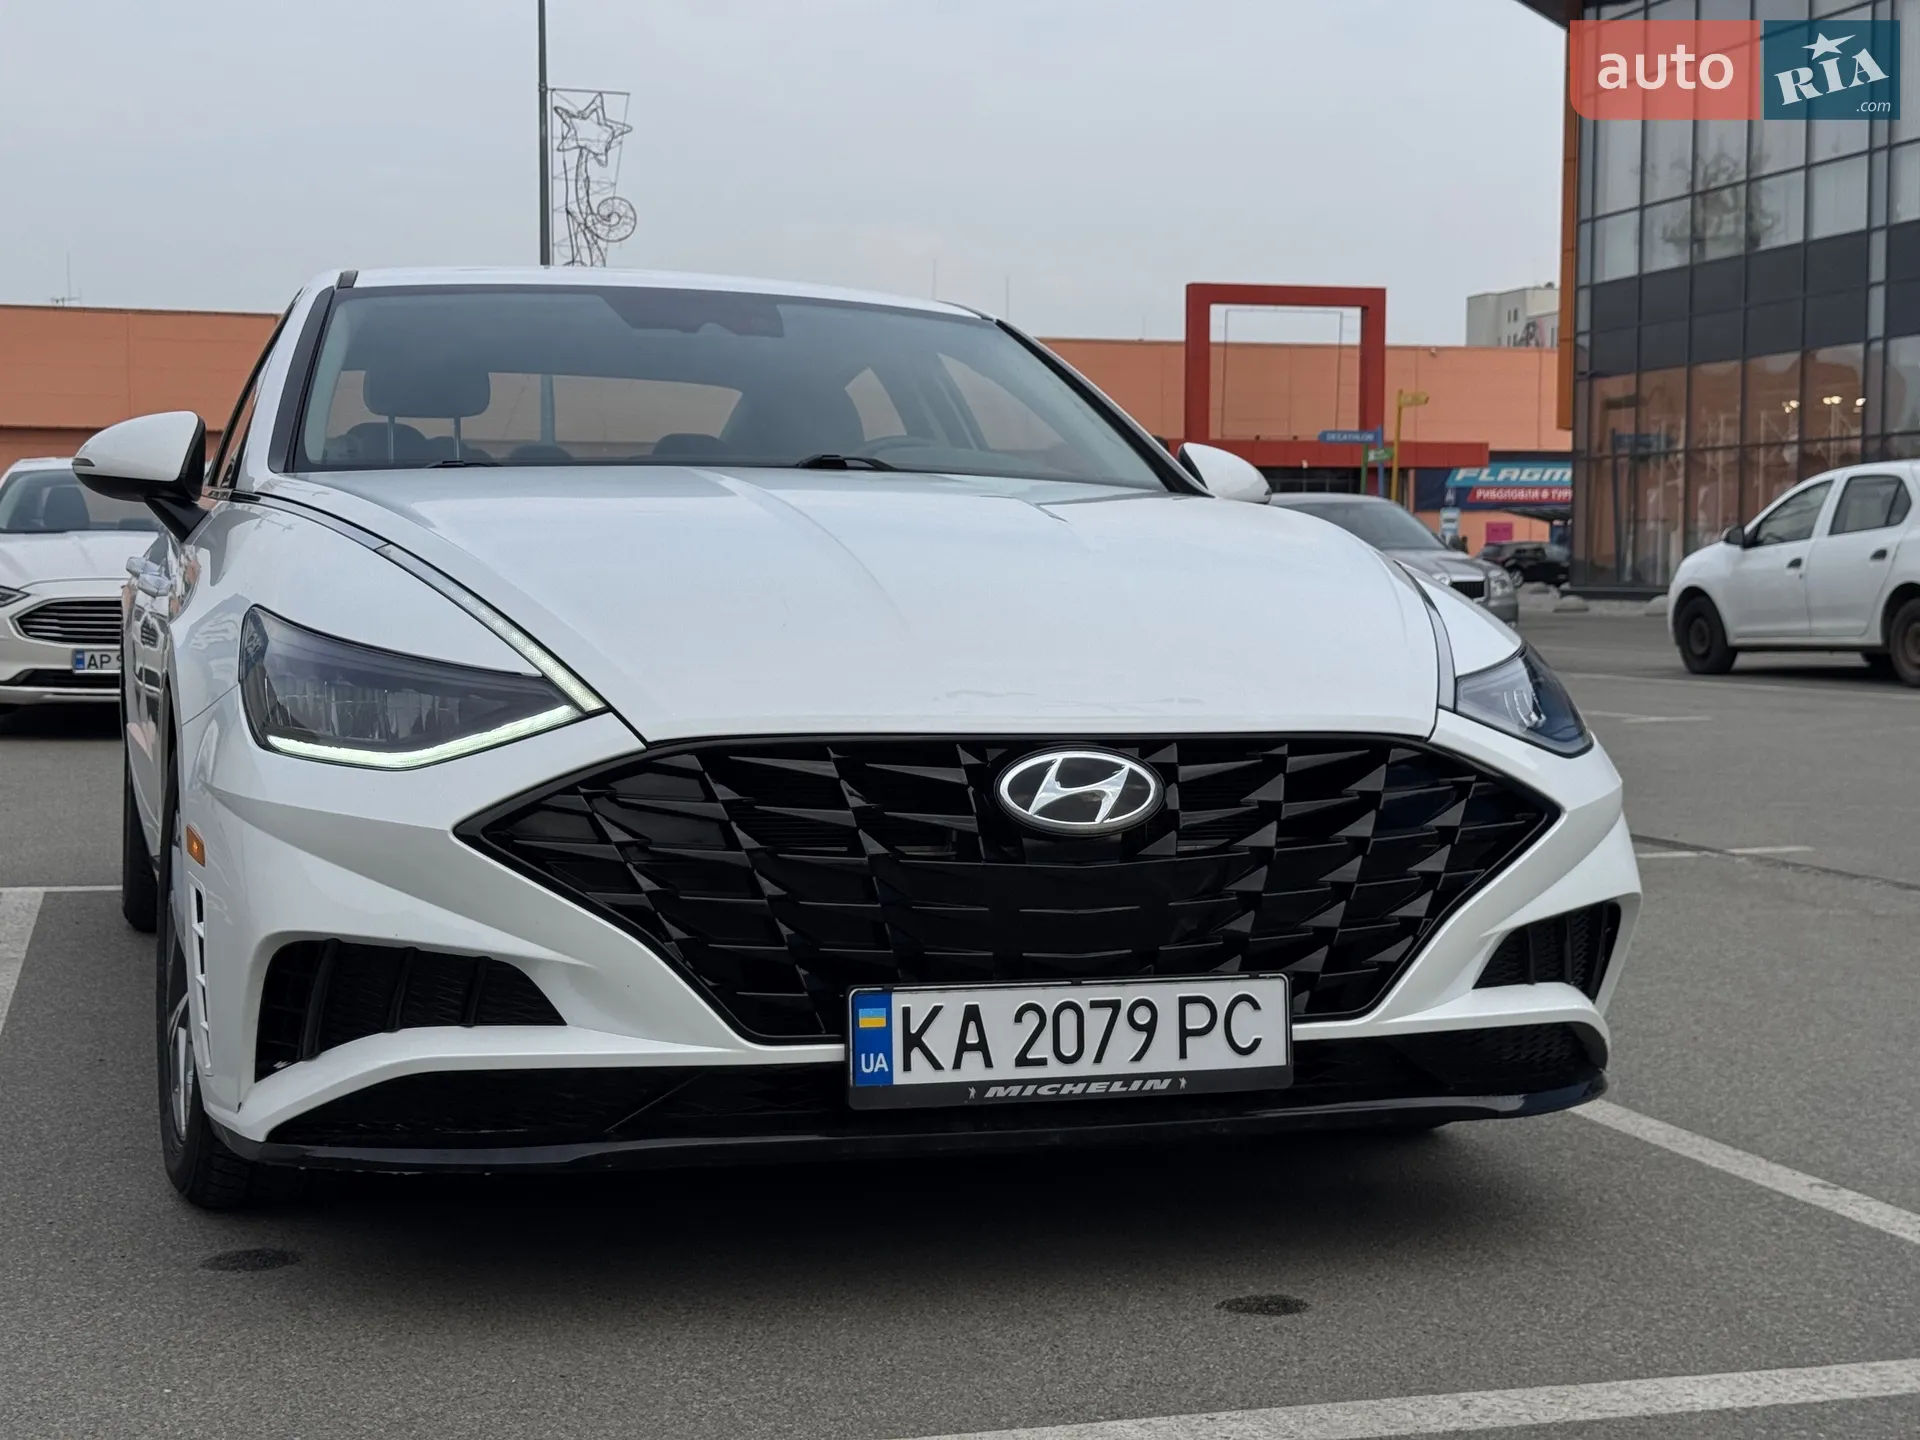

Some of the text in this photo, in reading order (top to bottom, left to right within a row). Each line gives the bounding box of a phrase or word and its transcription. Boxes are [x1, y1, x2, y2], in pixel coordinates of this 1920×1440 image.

[87, 653, 112, 669] AP
[901, 993, 1262, 1072] KA 2079 PC
[860, 1053, 889, 1074] UA
[984, 1077, 1173, 1099] MICHELIN
